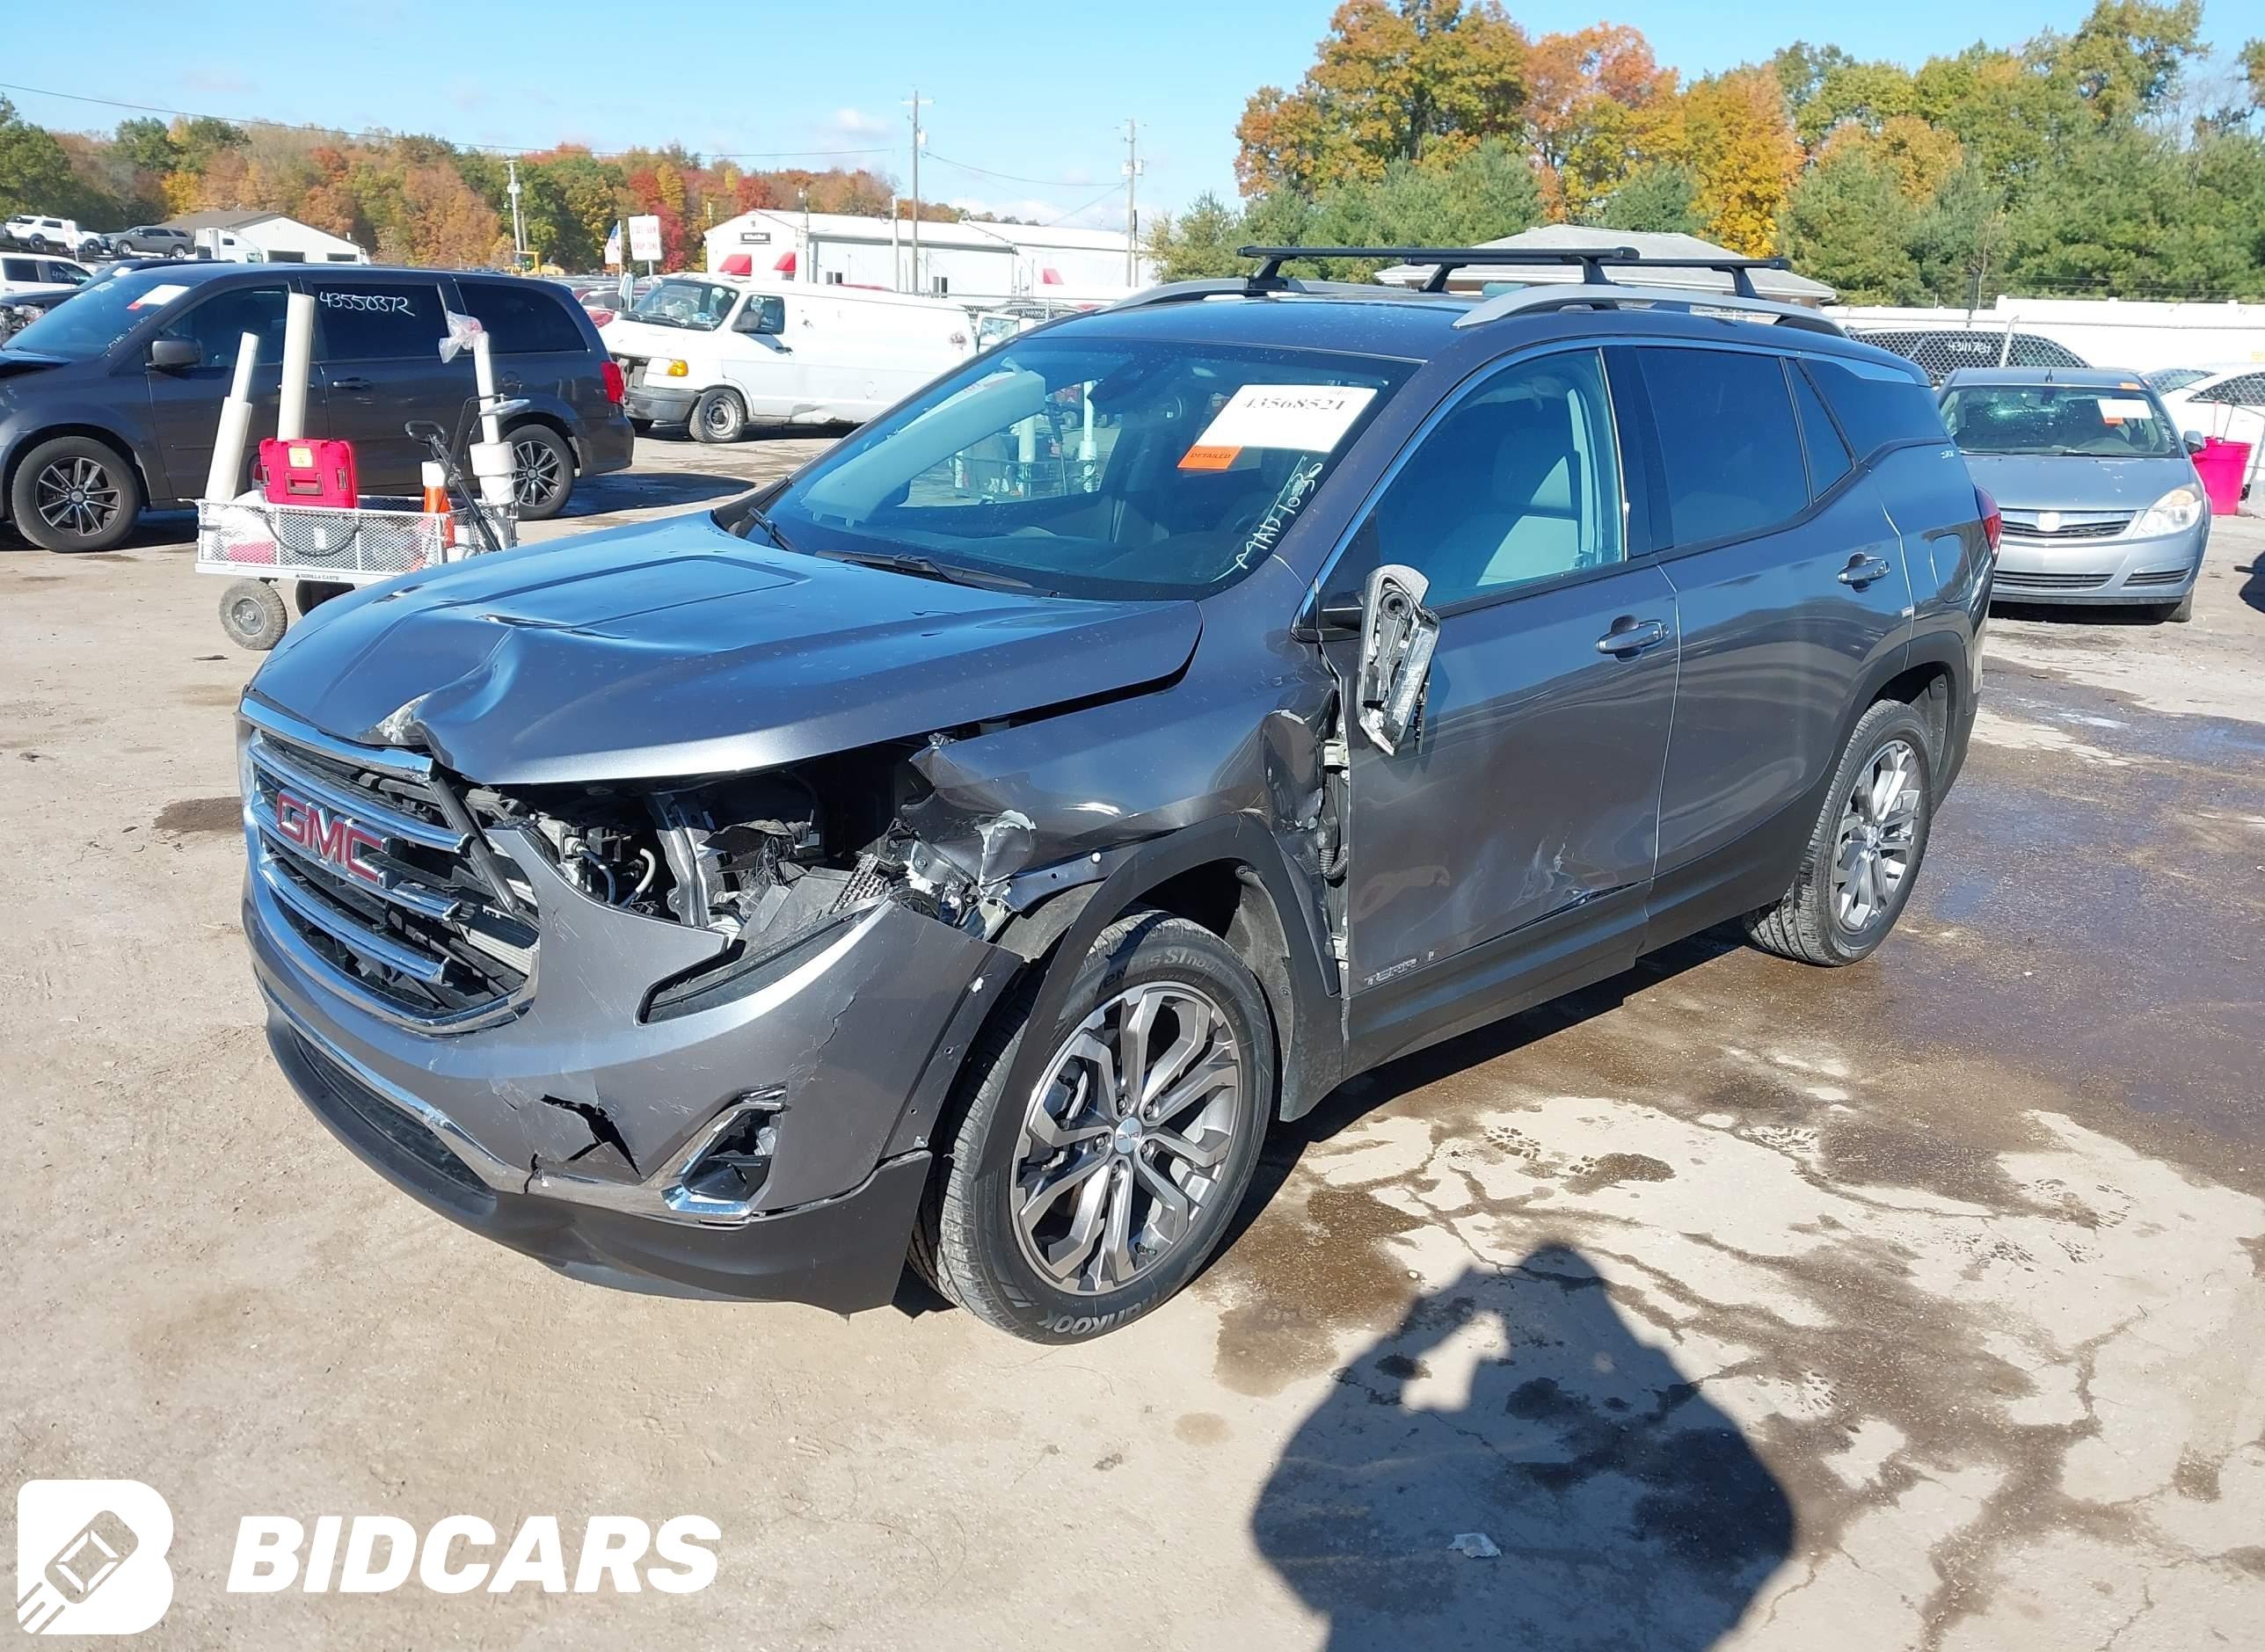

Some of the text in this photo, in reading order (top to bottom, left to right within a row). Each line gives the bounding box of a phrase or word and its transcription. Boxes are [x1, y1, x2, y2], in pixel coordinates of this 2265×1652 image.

[319, 291, 416, 317] 43550372
[275, 788, 389, 888] GMC
[1118, 1132, 1140, 1140] GMC
